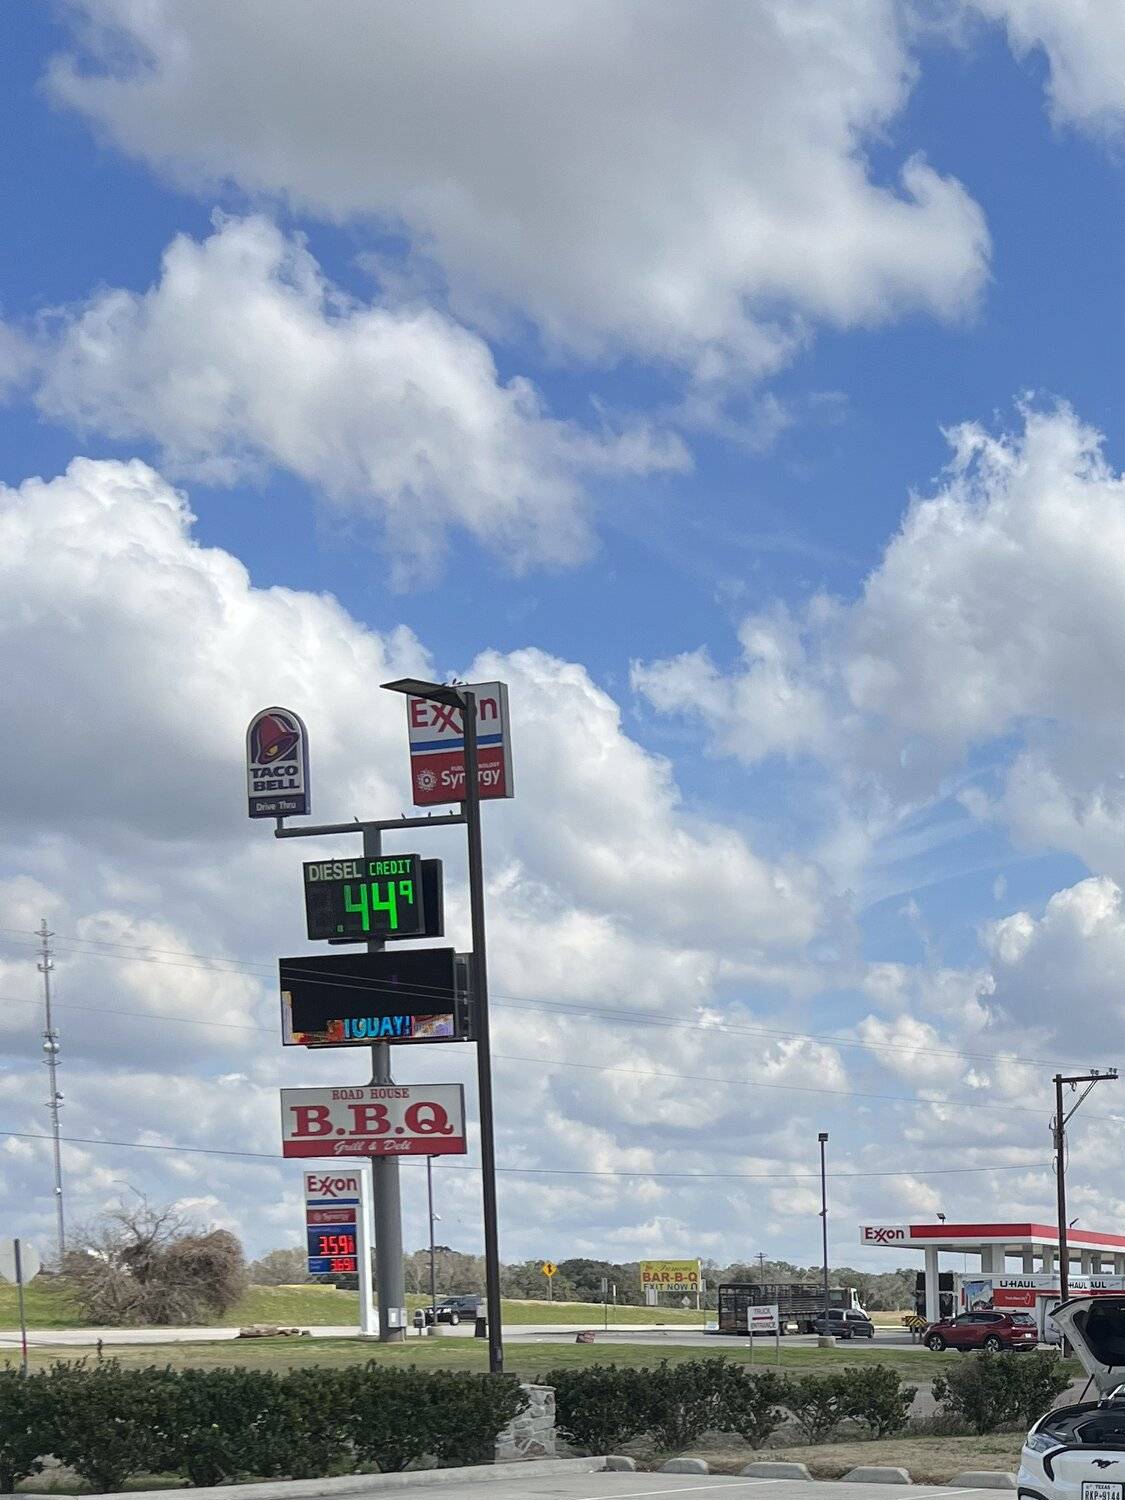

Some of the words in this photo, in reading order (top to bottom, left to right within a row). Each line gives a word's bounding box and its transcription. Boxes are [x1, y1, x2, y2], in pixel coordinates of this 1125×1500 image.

[410, 698, 498, 734] Exxn
[250, 765, 299, 778] TACO
[253, 779, 300, 791] BELL
[441, 769, 500, 789] Synrgy
[256, 803, 276, 811] Drive
[279, 801, 297, 809] Thru
[308, 861, 363, 881] DIESEL
[369, 860, 412, 875] CREDIT
[332, 1089, 364, 1100] ROAD
[370, 1088, 410, 1099] HOUSE
[290, 1102, 454, 1137] B.B.Q
[333, 1140, 364, 1154] Grill
[368, 1141, 378, 1151] &
[307, 1176, 357, 1197] Exxon
[865, 1227, 905, 1243] Exxon
[642, 1272, 698, 1282] BAR-B-Q
[643, 1283, 664, 1291] EXIT
[667, 1283, 688, 1291] NOW
